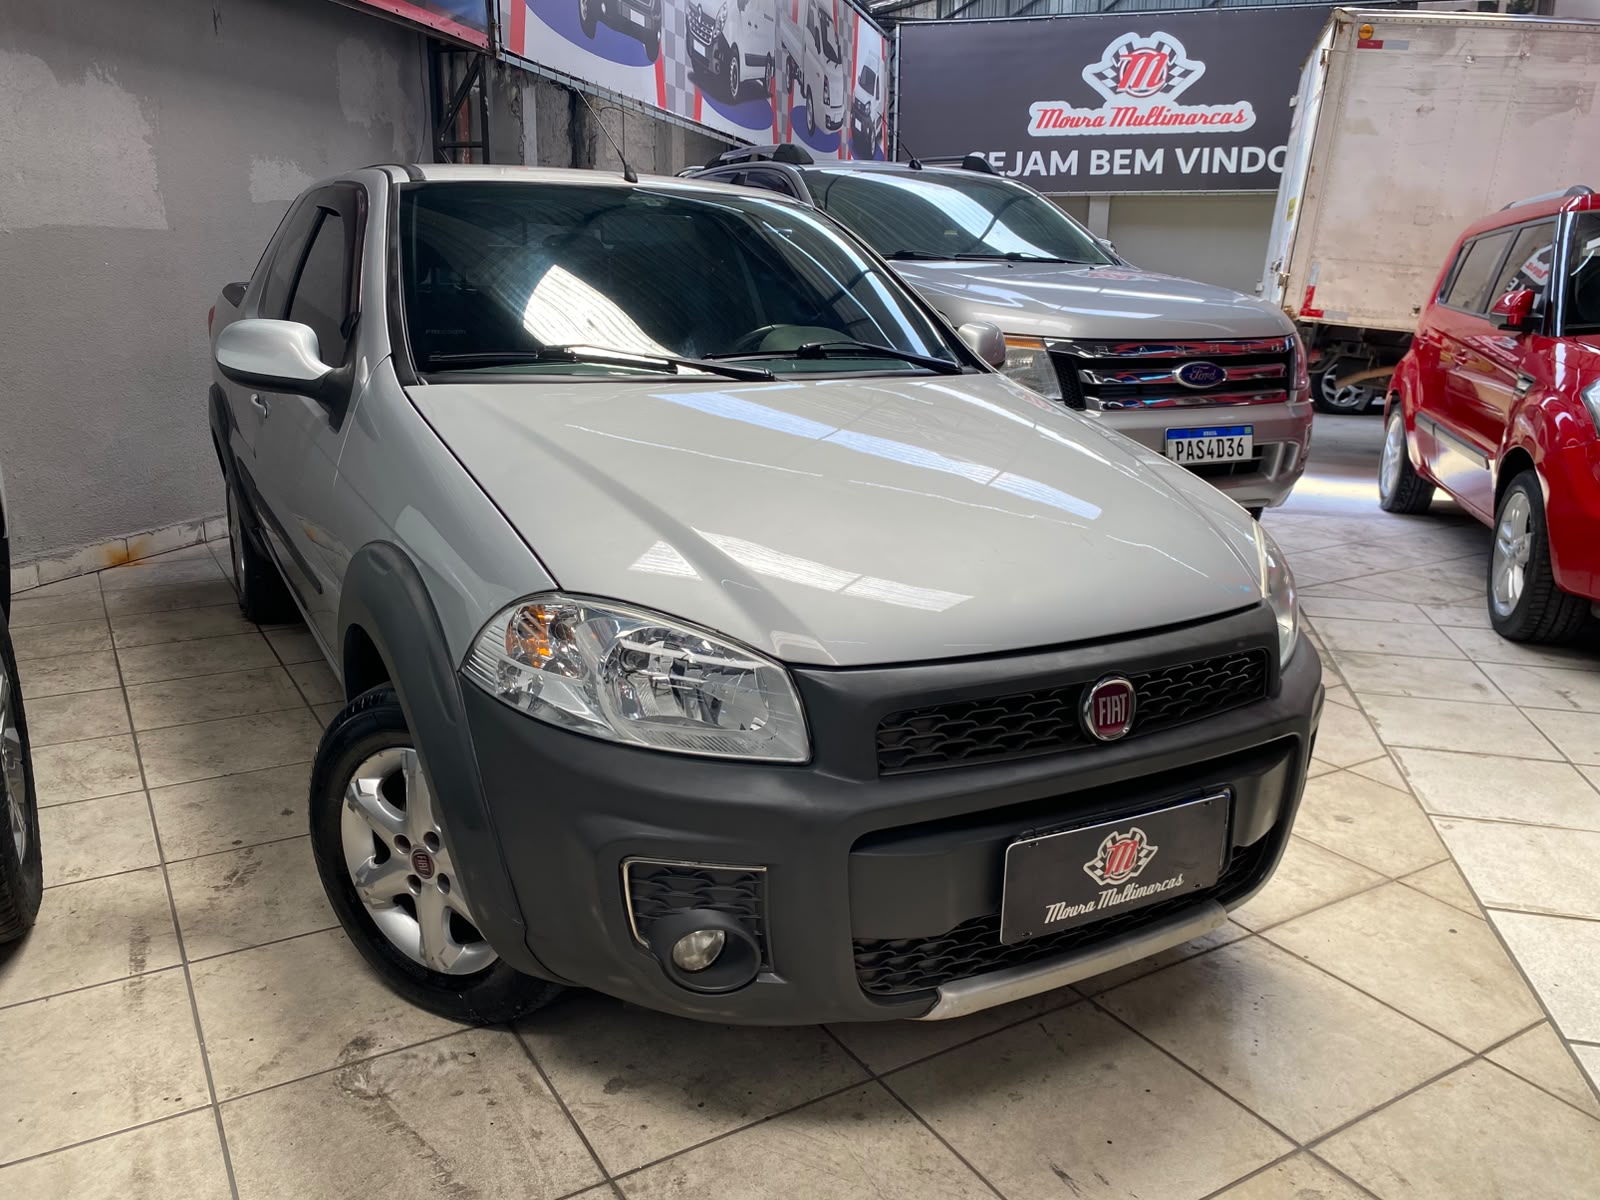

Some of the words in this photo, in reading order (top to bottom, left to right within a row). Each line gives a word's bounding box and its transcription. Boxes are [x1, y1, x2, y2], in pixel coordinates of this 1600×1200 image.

[1035, 108, 1107, 129] Moura
[1109, 105, 1248, 128] Multimarcas
[1089, 148, 1164, 176] BEM
[1188, 366, 1217, 381] Ford
[1175, 437, 1244, 461] PAS4D36
[1098, 693, 1127, 726] FIAT
[1044, 901, 1096, 924] Moura
[1097, 873, 1184, 910] Multimarcas
